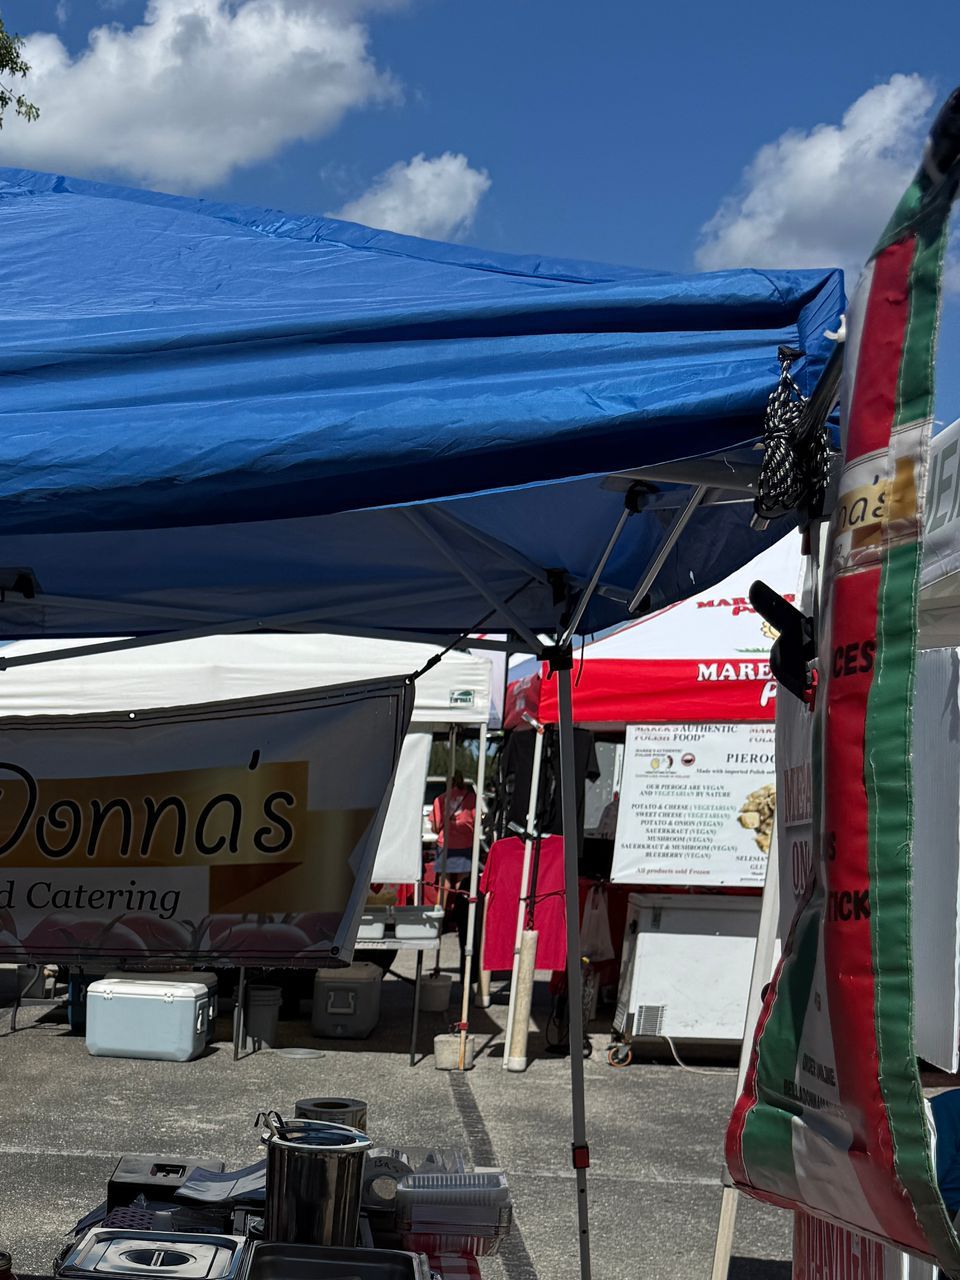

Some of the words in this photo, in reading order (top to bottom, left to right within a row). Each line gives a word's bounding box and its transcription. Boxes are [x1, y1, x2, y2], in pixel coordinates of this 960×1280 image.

[681, 725, 738, 733] AUTHENTIC
[696, 820, 724, 828] (VEGAN)
[689, 828, 717, 836] (VEGAN)
[686, 836, 713, 844] (VEGAN)
[684, 852, 711, 860] (VEGAN)
[646, 868, 674, 876] products
[26, 880, 181, 920] Catering
